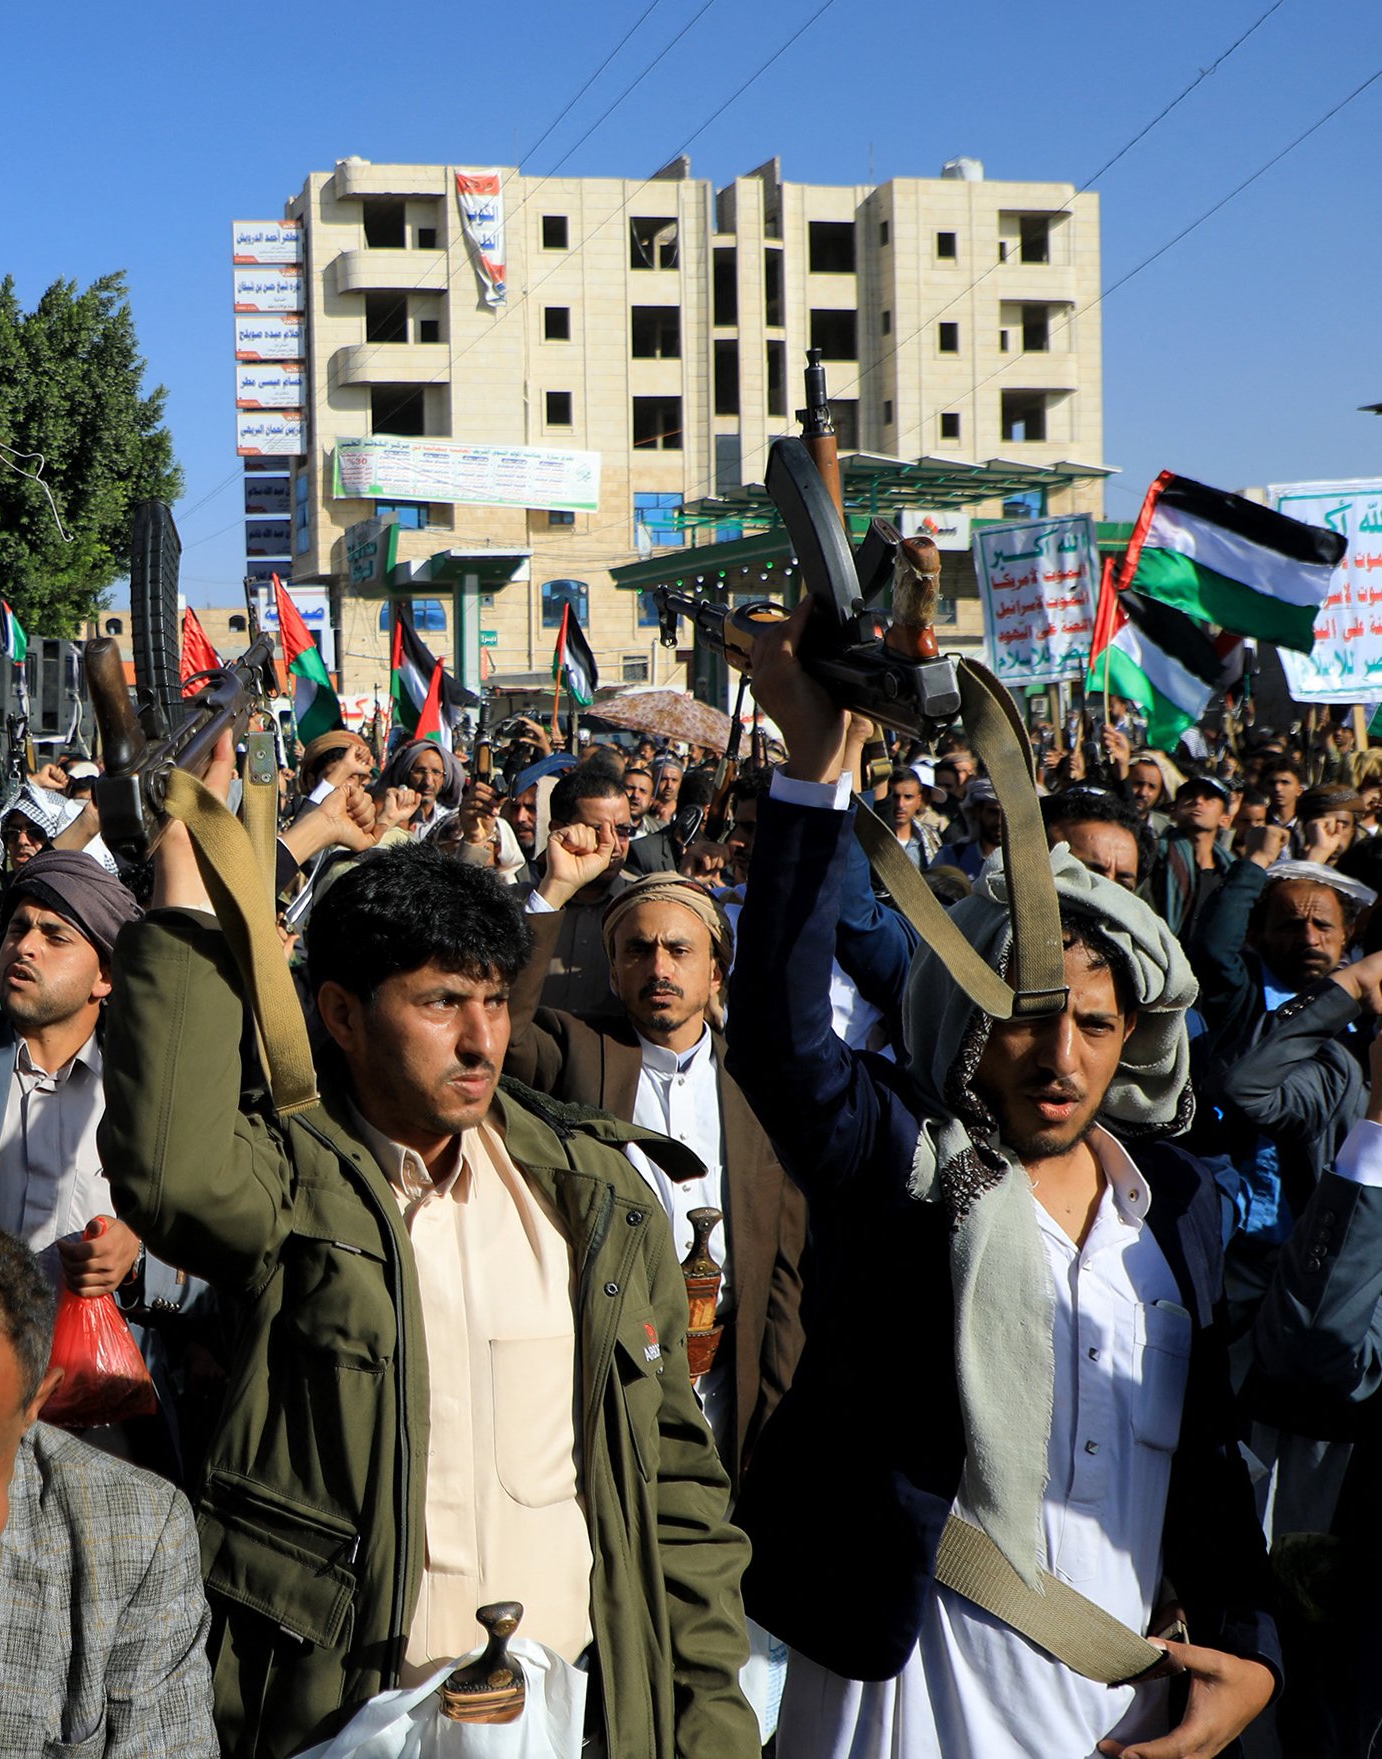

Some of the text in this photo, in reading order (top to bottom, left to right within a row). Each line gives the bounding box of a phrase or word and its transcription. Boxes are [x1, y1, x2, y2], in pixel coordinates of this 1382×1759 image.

[1359, 501, 1382, 534] له
[1043, 562, 1088, 585] الموت
[1045, 591, 1090, 612] الموت
[998, 624, 1033, 646] اليهود
